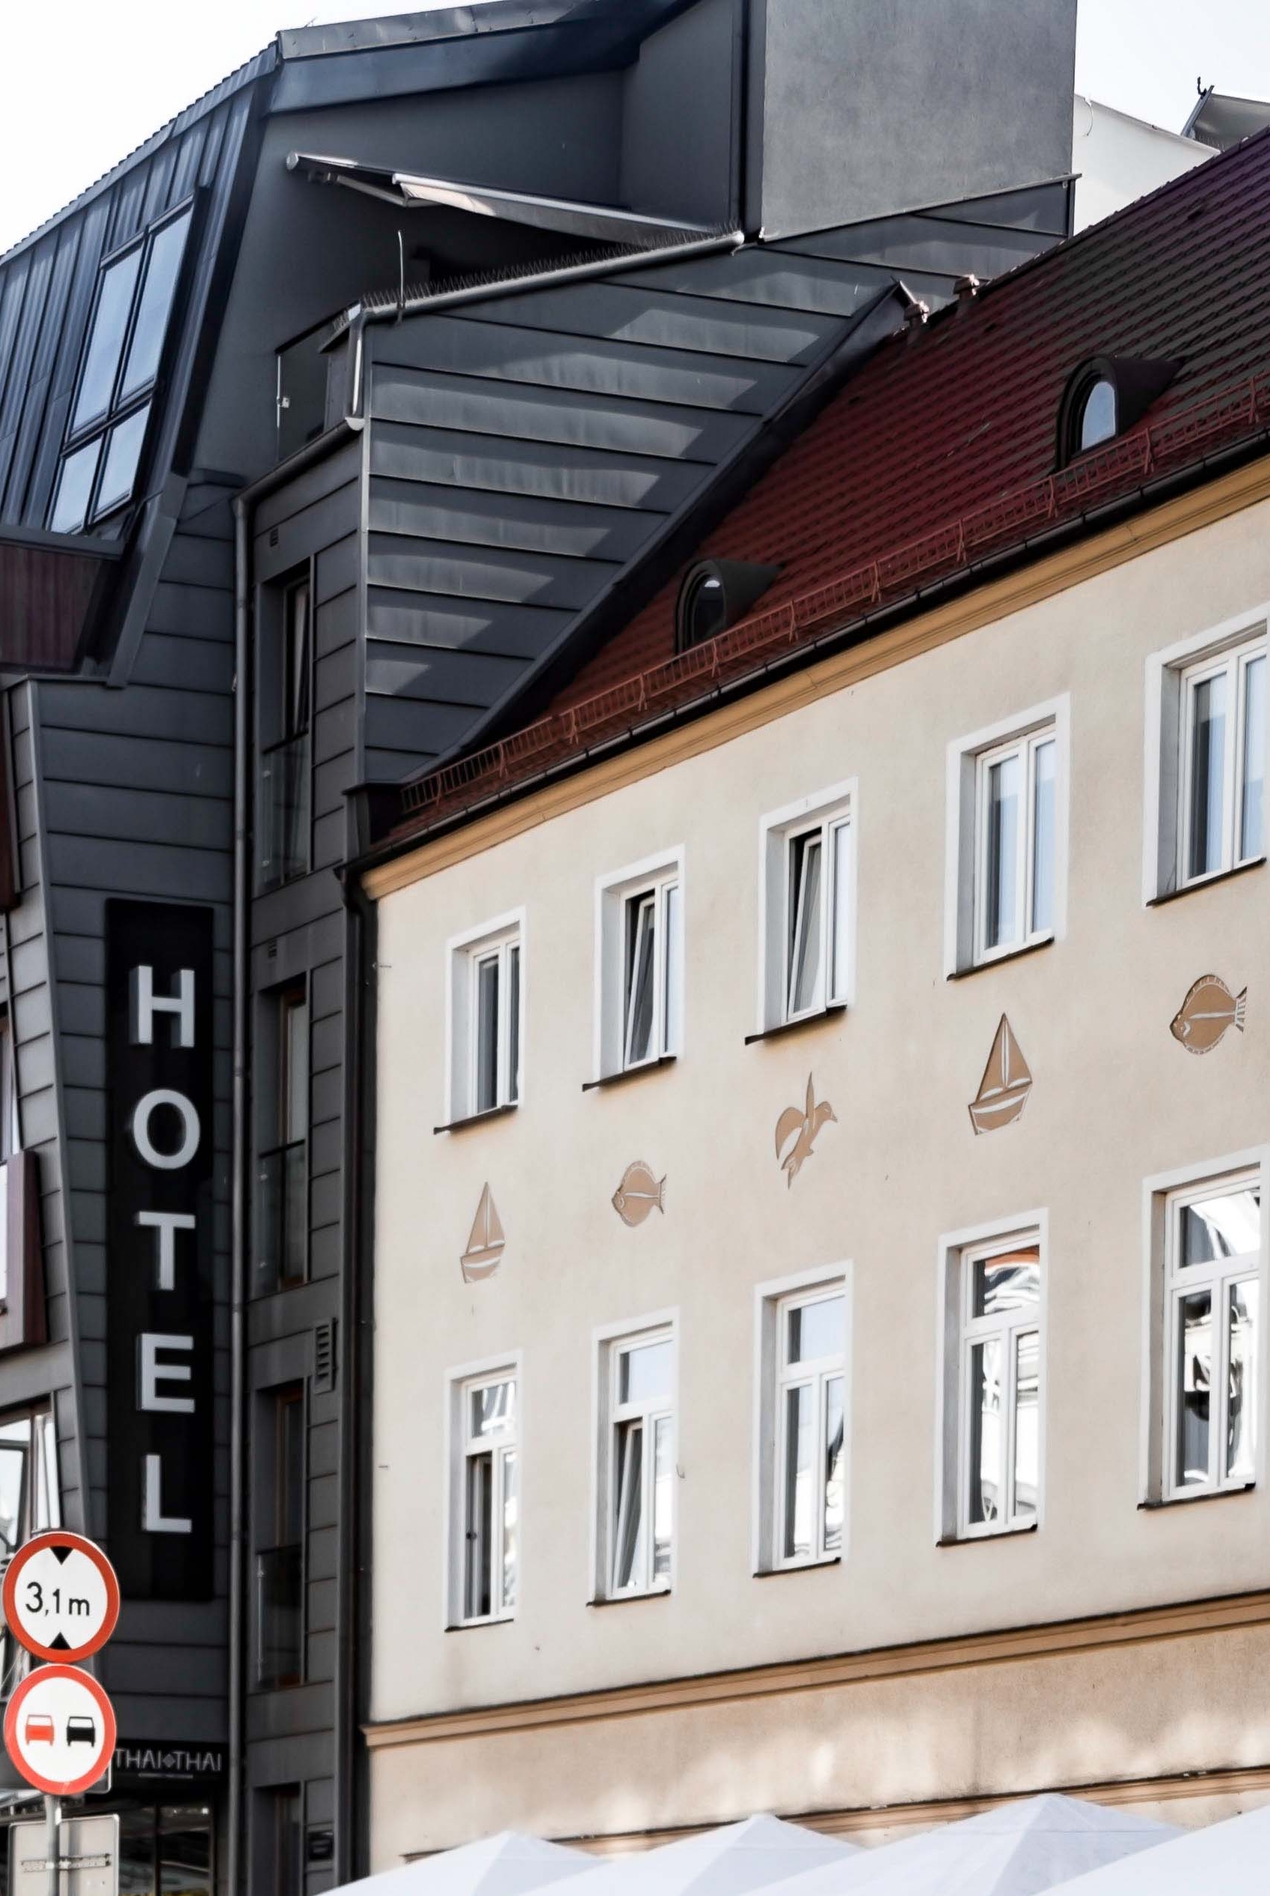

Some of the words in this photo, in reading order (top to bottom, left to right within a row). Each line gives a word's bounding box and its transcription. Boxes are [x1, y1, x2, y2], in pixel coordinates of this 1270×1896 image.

[131, 965, 202, 1533] HOTEL
[25, 1581, 61, 1617] 3,1
[68, 1597, 90, 1616] m
[115, 1748, 162, 1769] THAI
[172, 1750, 222, 1771] THAI
